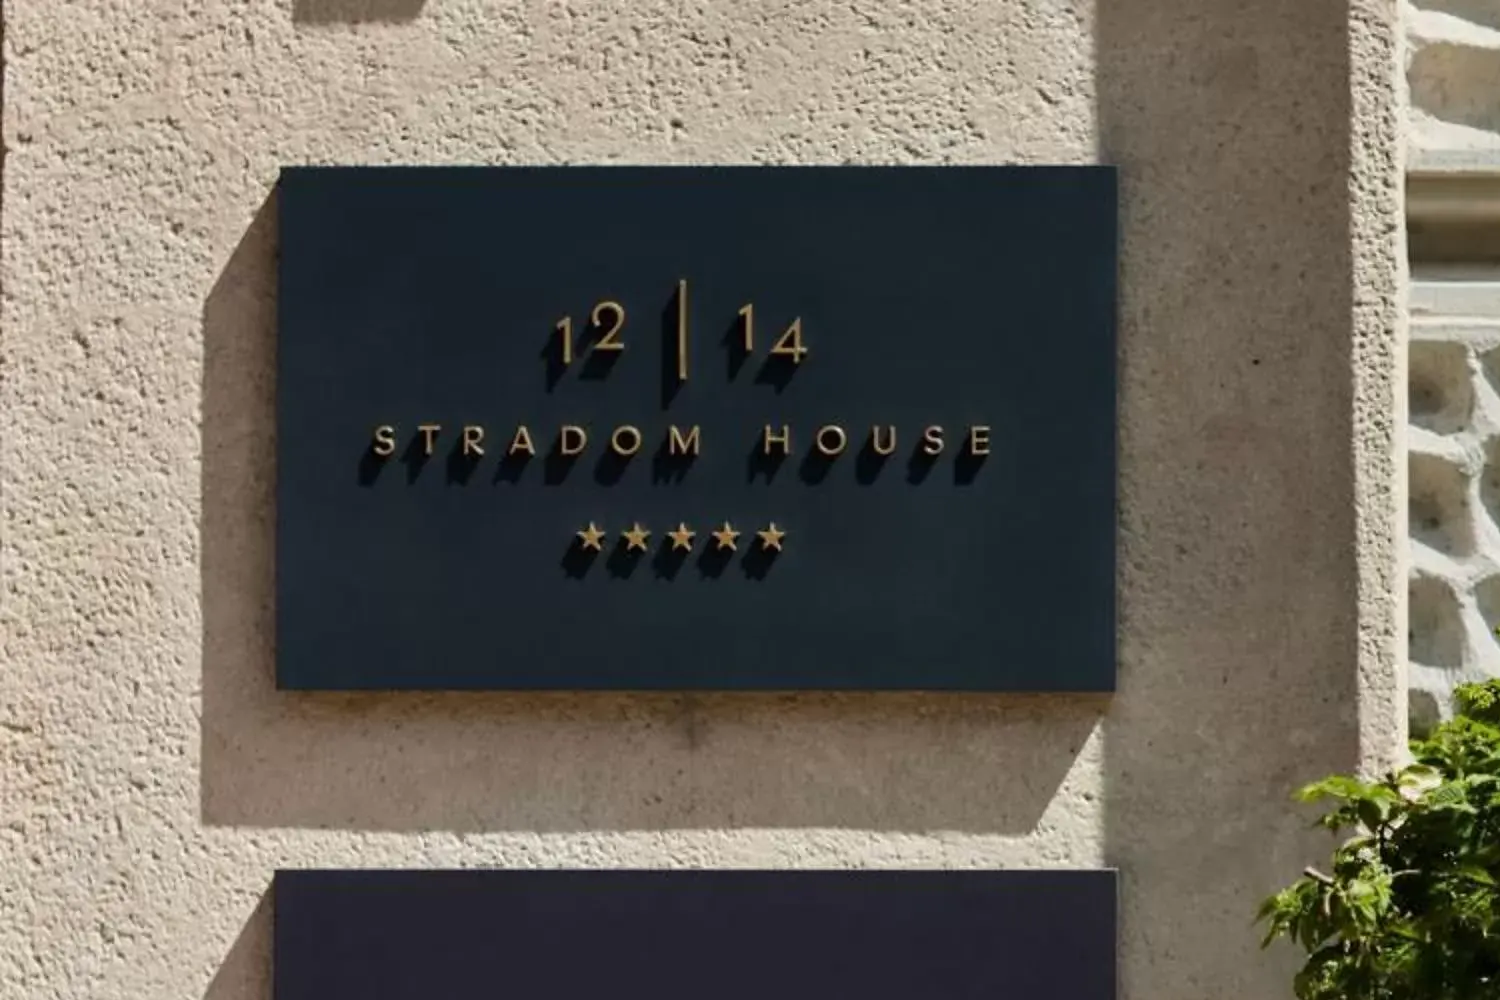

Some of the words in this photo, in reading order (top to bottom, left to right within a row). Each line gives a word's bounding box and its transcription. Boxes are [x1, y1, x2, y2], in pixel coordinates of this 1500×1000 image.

[556, 300, 625, 364] 12
[738, 303, 809, 363] 14
[374, 424, 701, 455] STRADOM
[764, 424, 991, 455] HOUSE
